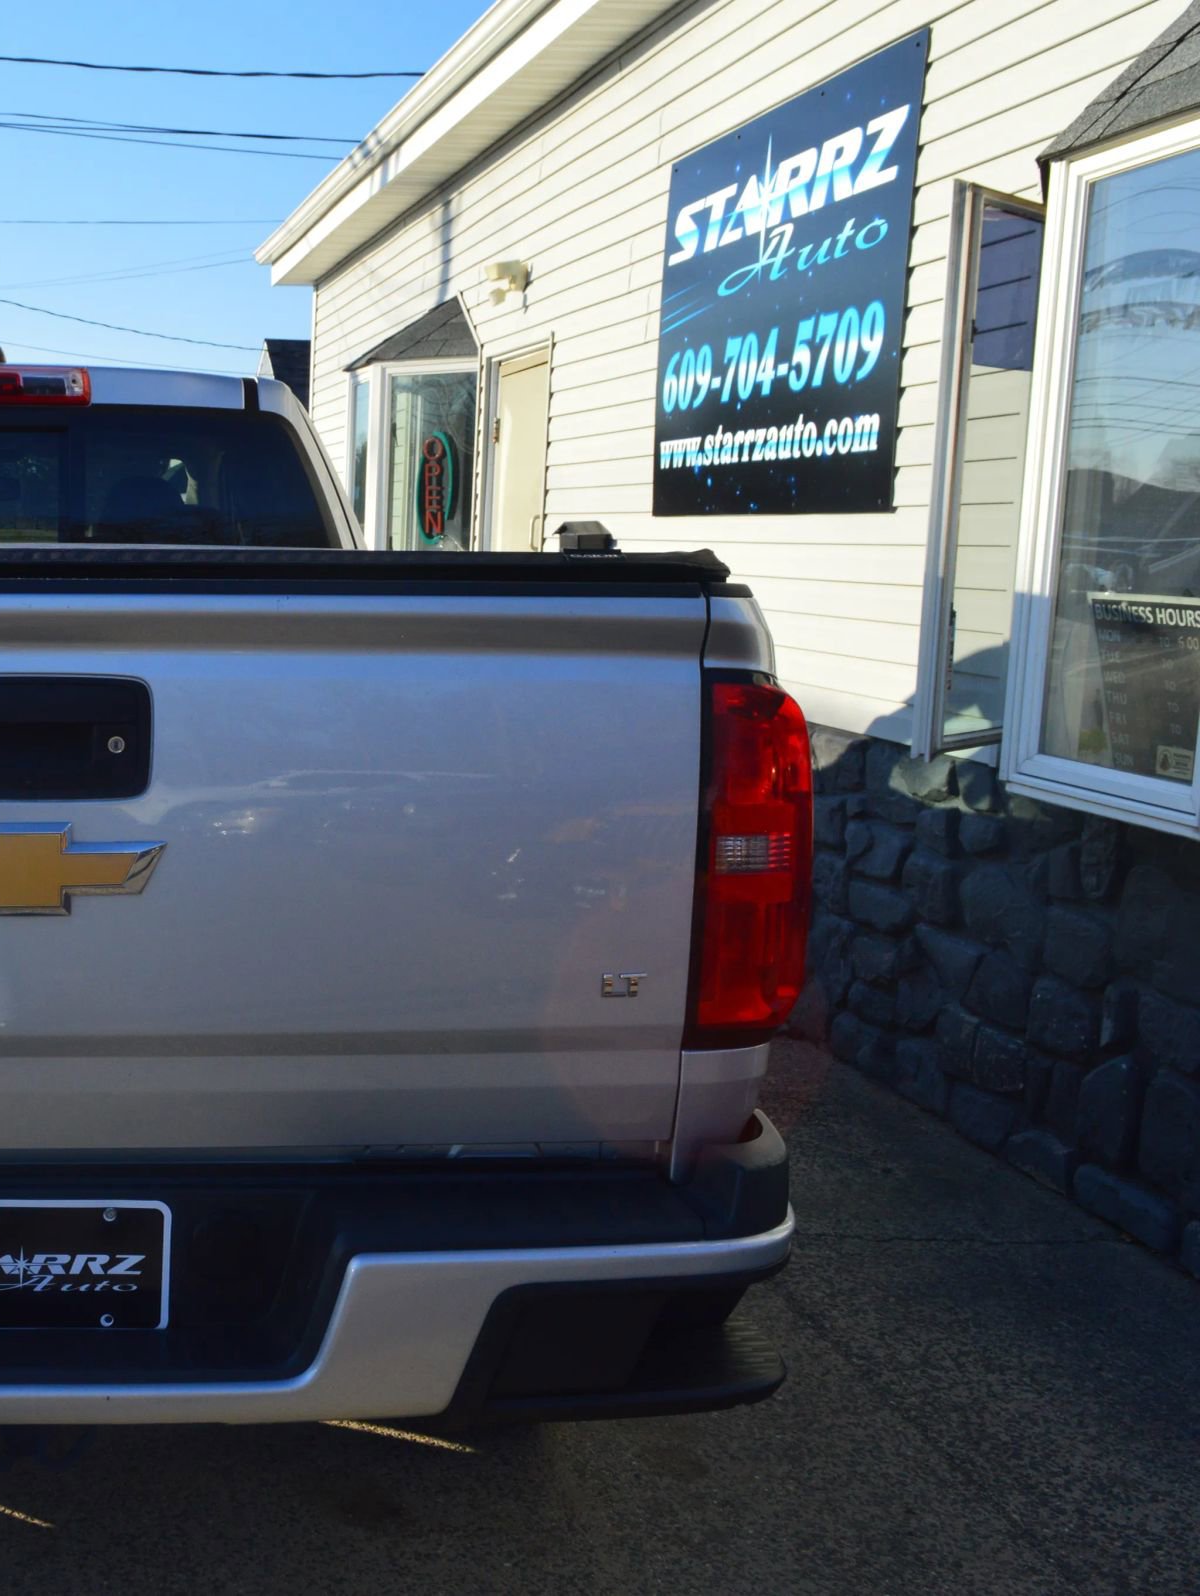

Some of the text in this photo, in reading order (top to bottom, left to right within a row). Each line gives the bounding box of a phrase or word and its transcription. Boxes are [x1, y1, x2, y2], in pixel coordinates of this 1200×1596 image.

[667, 103, 911, 266] STARRZ
[717, 217, 889, 297] Auto
[662, 300, 886, 414] 609-704-5709
[659, 412, 881, 469] www.starrzauto.com
[423, 437, 443, 533] OPEN
[1095, 603, 1200, 629] BUSINESS HOURS
[601, 972, 648, 998] LT
